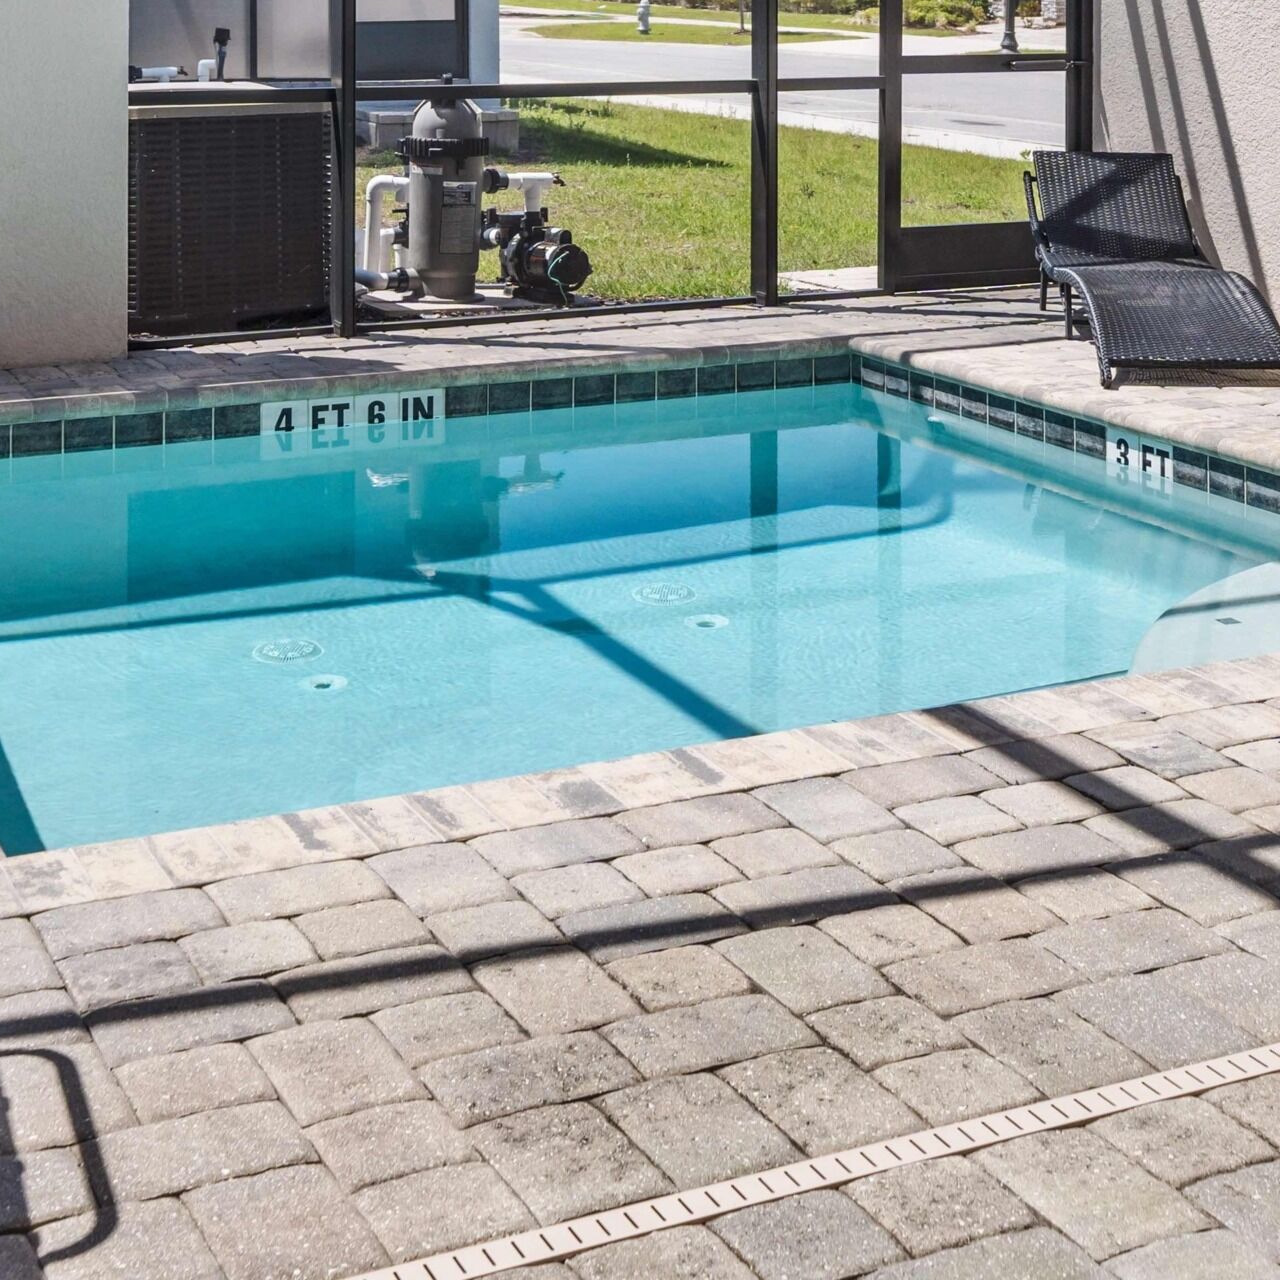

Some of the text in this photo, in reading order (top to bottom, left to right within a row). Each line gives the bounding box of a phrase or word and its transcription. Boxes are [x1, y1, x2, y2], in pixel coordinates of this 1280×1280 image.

[274, 396, 434, 432] 4 FT 6 IN
[1116, 438, 1170, 478] 3 FT
